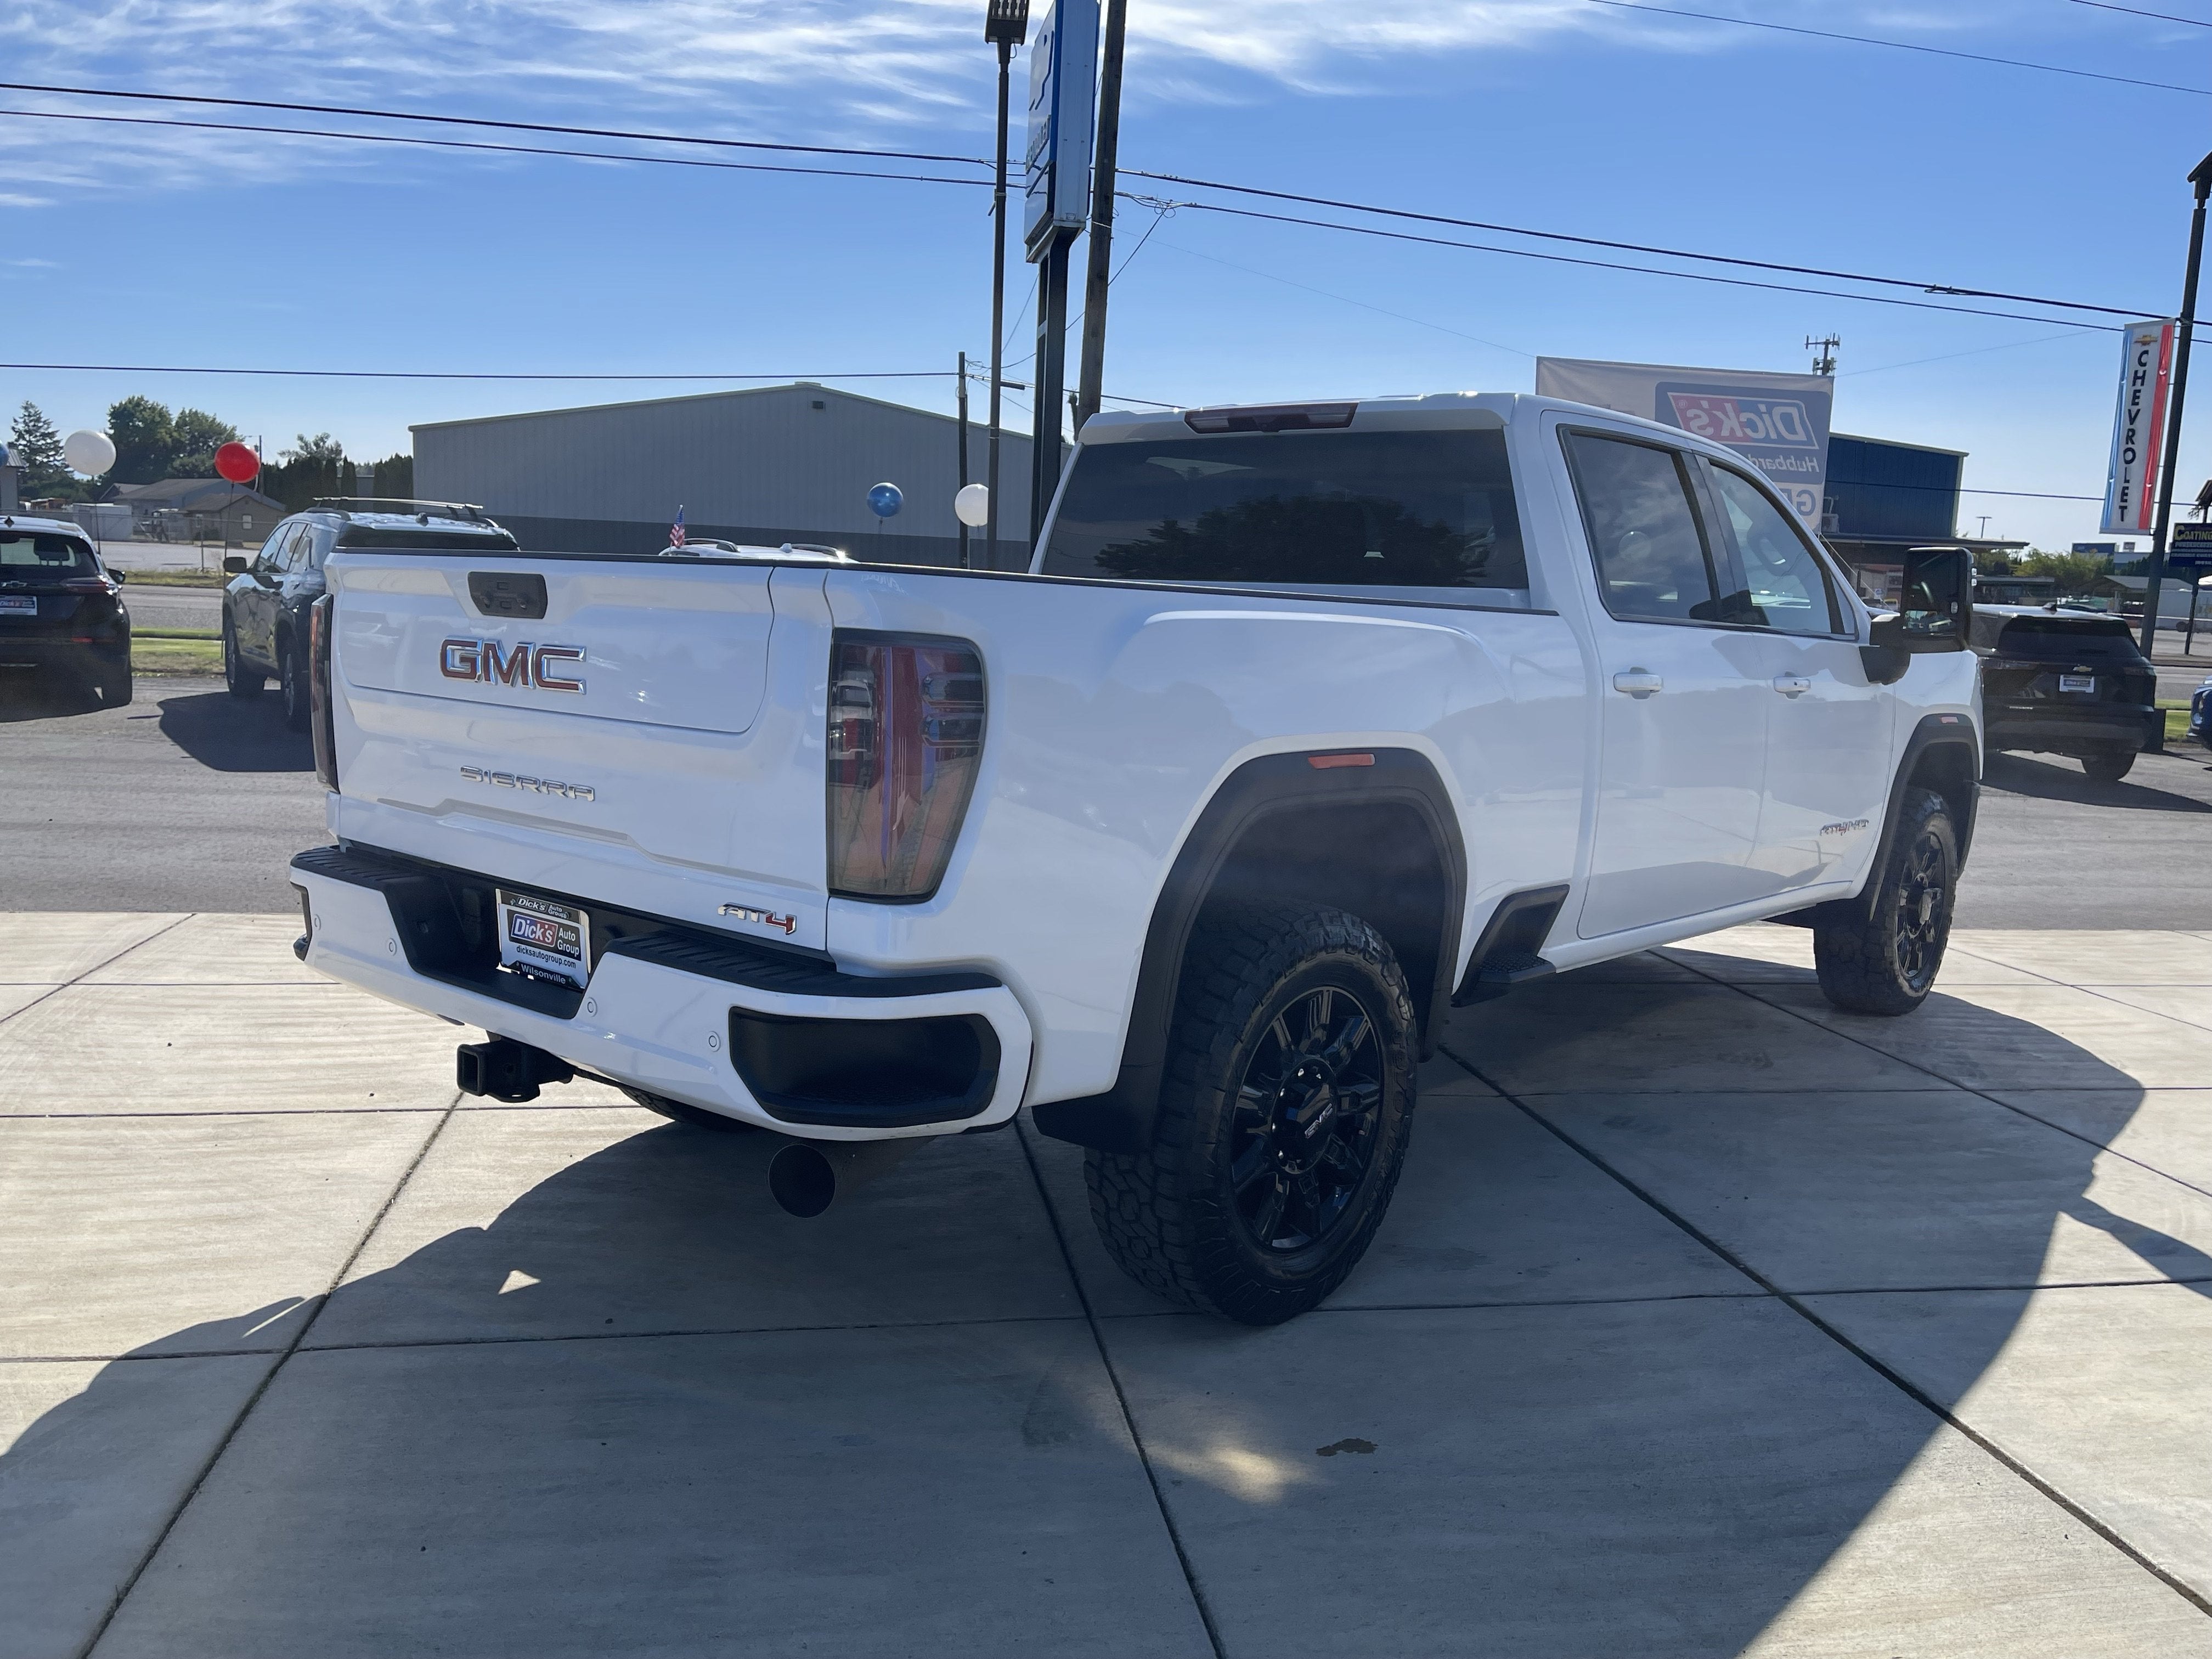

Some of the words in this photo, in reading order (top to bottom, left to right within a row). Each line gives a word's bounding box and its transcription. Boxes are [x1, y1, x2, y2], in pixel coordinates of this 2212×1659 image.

[2118, 349, 2149, 522] CHEVROLET
[440, 635, 586, 695] GMC
[460, 765, 595, 802] SIERRA
[518, 898, 546, 911] Dick's
[514, 918, 554, 943] Dick's
[718, 902, 797, 935] AT4
[558, 927, 575, 941] Auto
[516, 944, 577, 969] dicksautogroup.com
[557, 939, 580, 957] Group
[521, 963, 566, 984] Wilsonville
[1304, 1103, 1334, 1139] GMC
